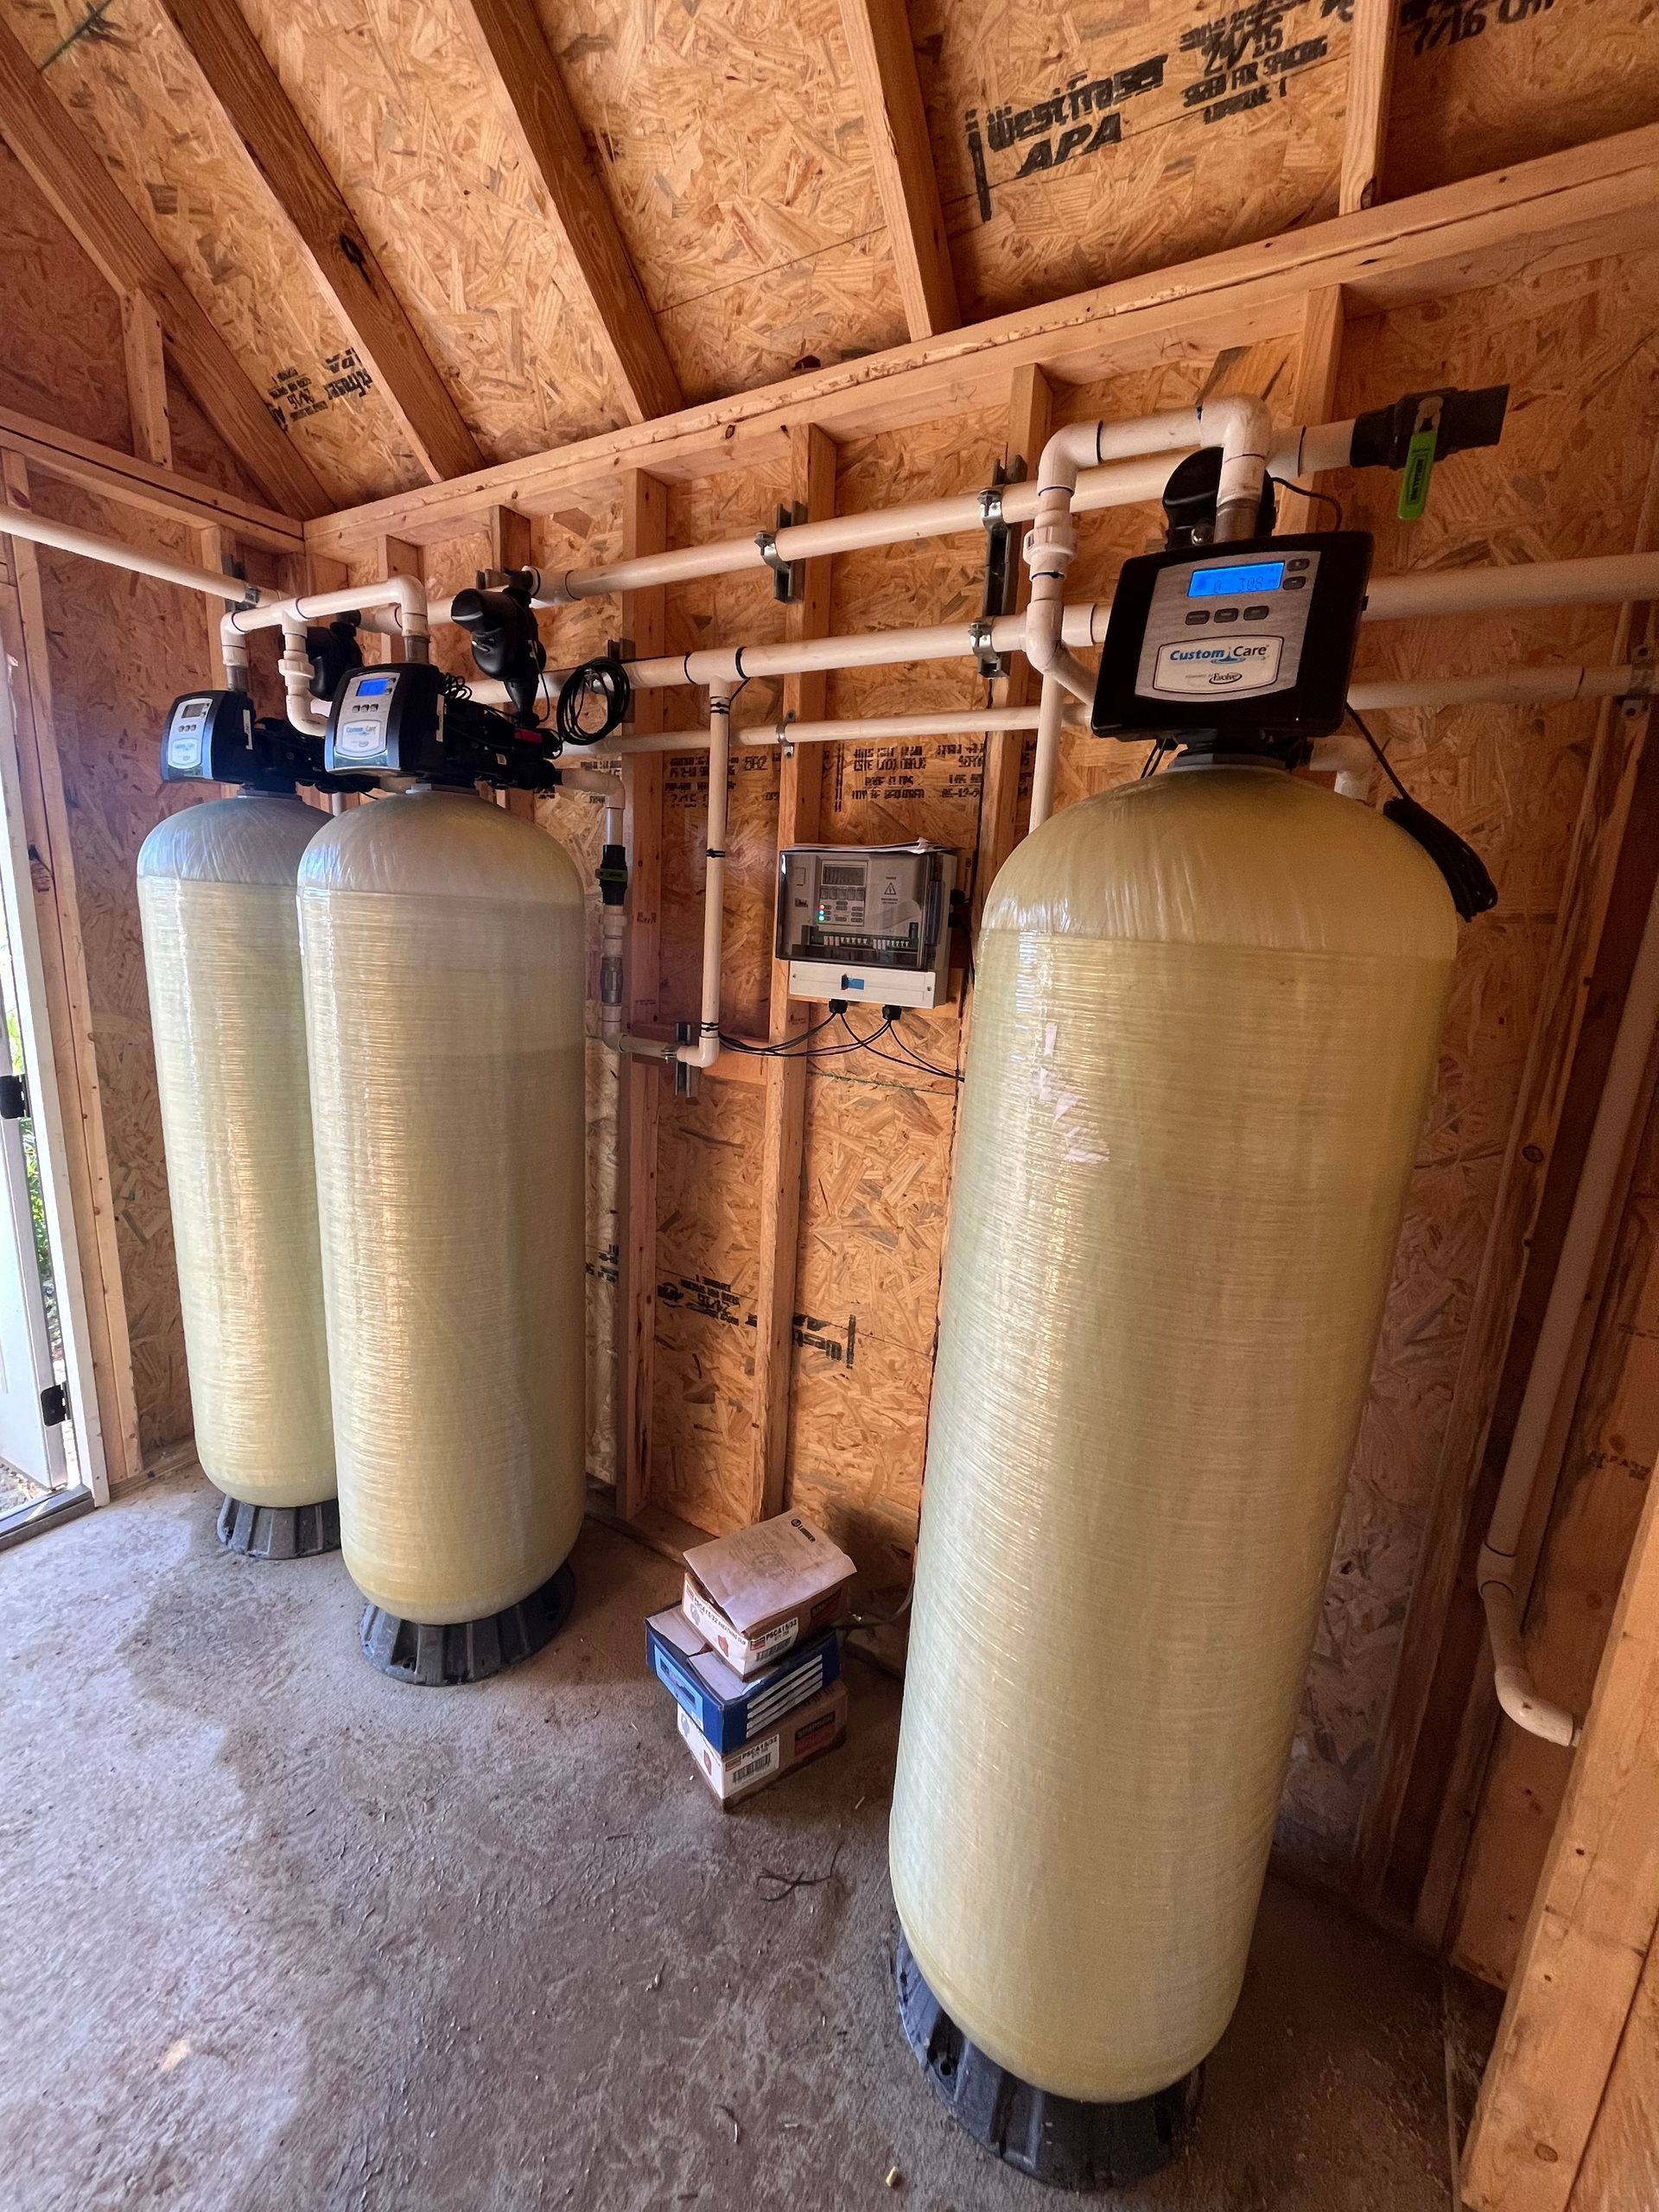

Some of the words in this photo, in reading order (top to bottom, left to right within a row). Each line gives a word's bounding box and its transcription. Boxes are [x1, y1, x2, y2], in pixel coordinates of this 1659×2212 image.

[1015, 113, 1122, 178] APA
[1170, 649, 1225, 661] Custom
[1233, 645, 1268, 658] Care
[1212, 671, 1239, 683] Evolve
